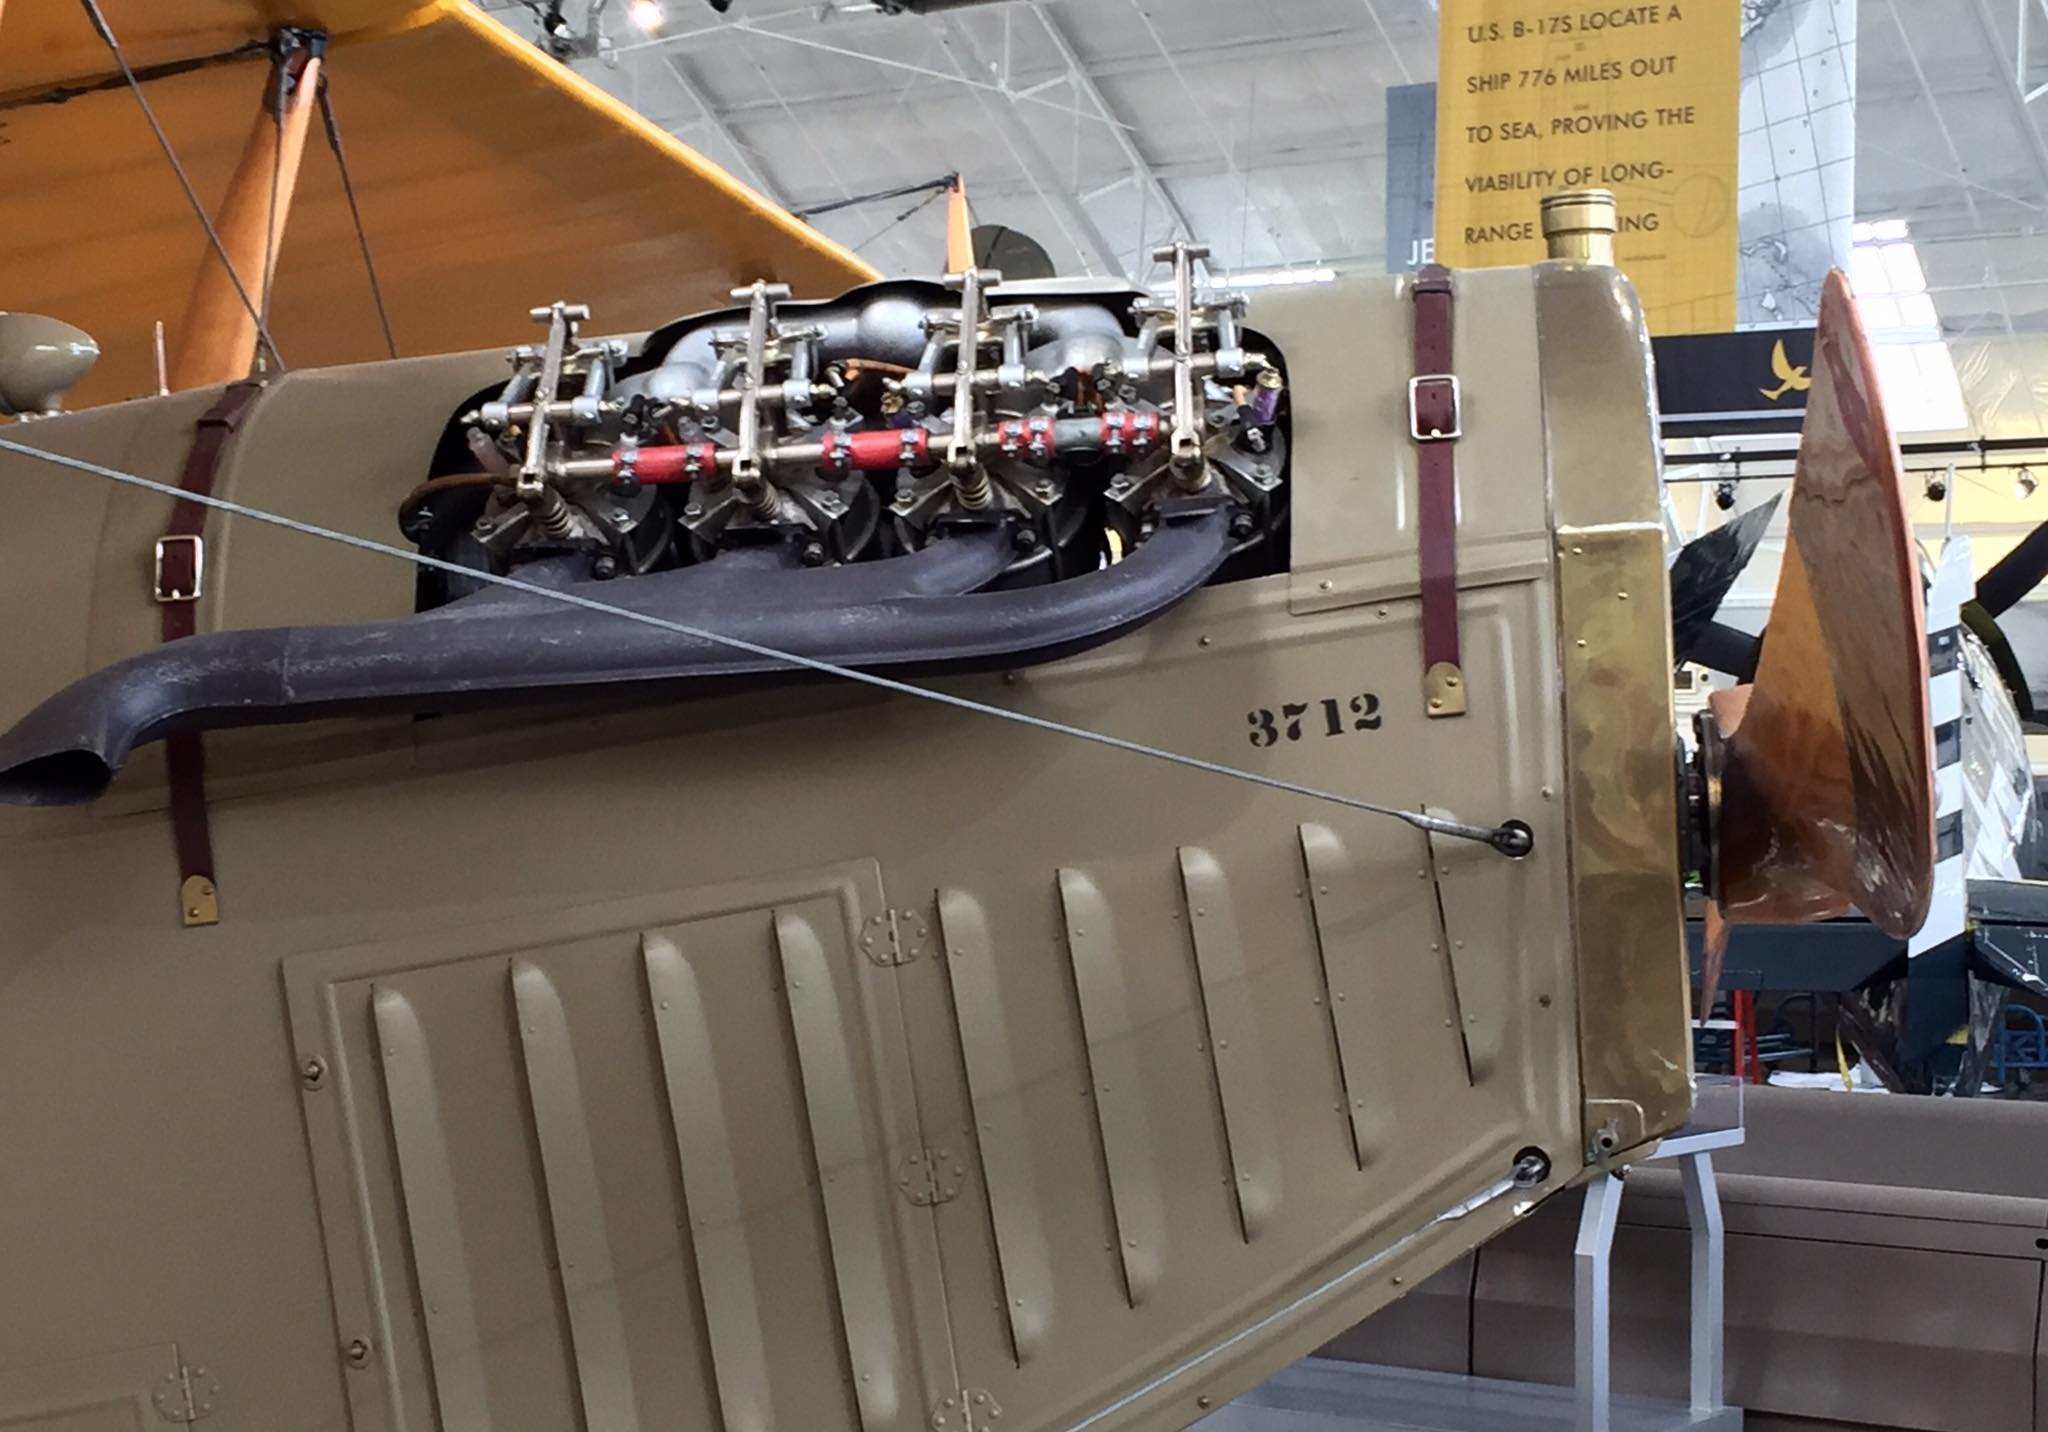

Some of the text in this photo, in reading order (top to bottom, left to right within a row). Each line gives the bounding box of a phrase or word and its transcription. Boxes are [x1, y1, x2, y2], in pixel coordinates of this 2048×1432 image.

[1467, 4, 1683, 43] U.S. B-17S LOCATE A
[1466, 55, 1678, 94] SHIP 776 MILES OUT
[1465, 106, 1695, 144] TO SEA, PROVING THE
[1465, 160, 1674, 193] VIABILITY OF LONG-
[1464, 211, 1660, 245] RANGE ING
[1247, 692, 1382, 747] 3712
